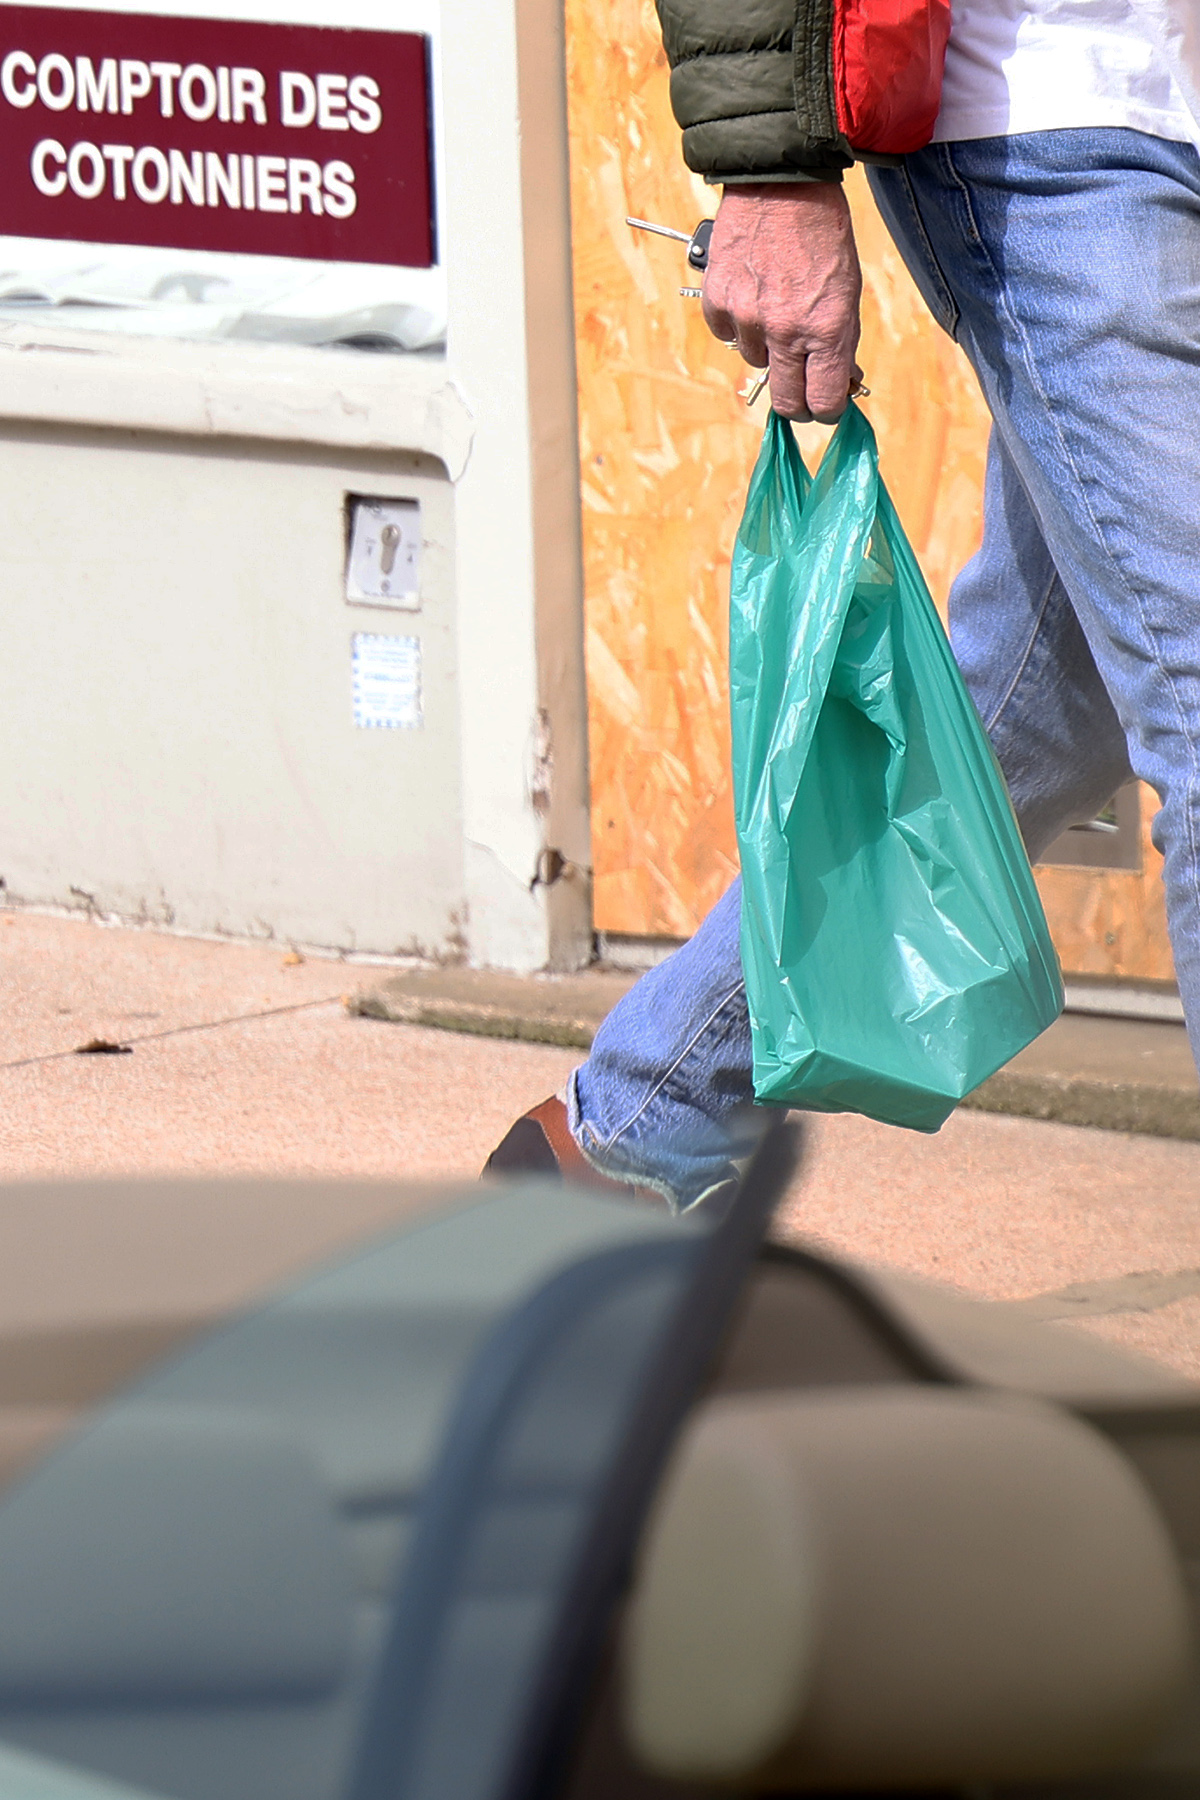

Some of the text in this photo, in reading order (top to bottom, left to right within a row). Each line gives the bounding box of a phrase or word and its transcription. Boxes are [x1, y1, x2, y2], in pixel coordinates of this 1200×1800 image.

[1, 50, 383, 134] COMPTOIR DES
[31, 138, 357, 219] COTONNIERS
